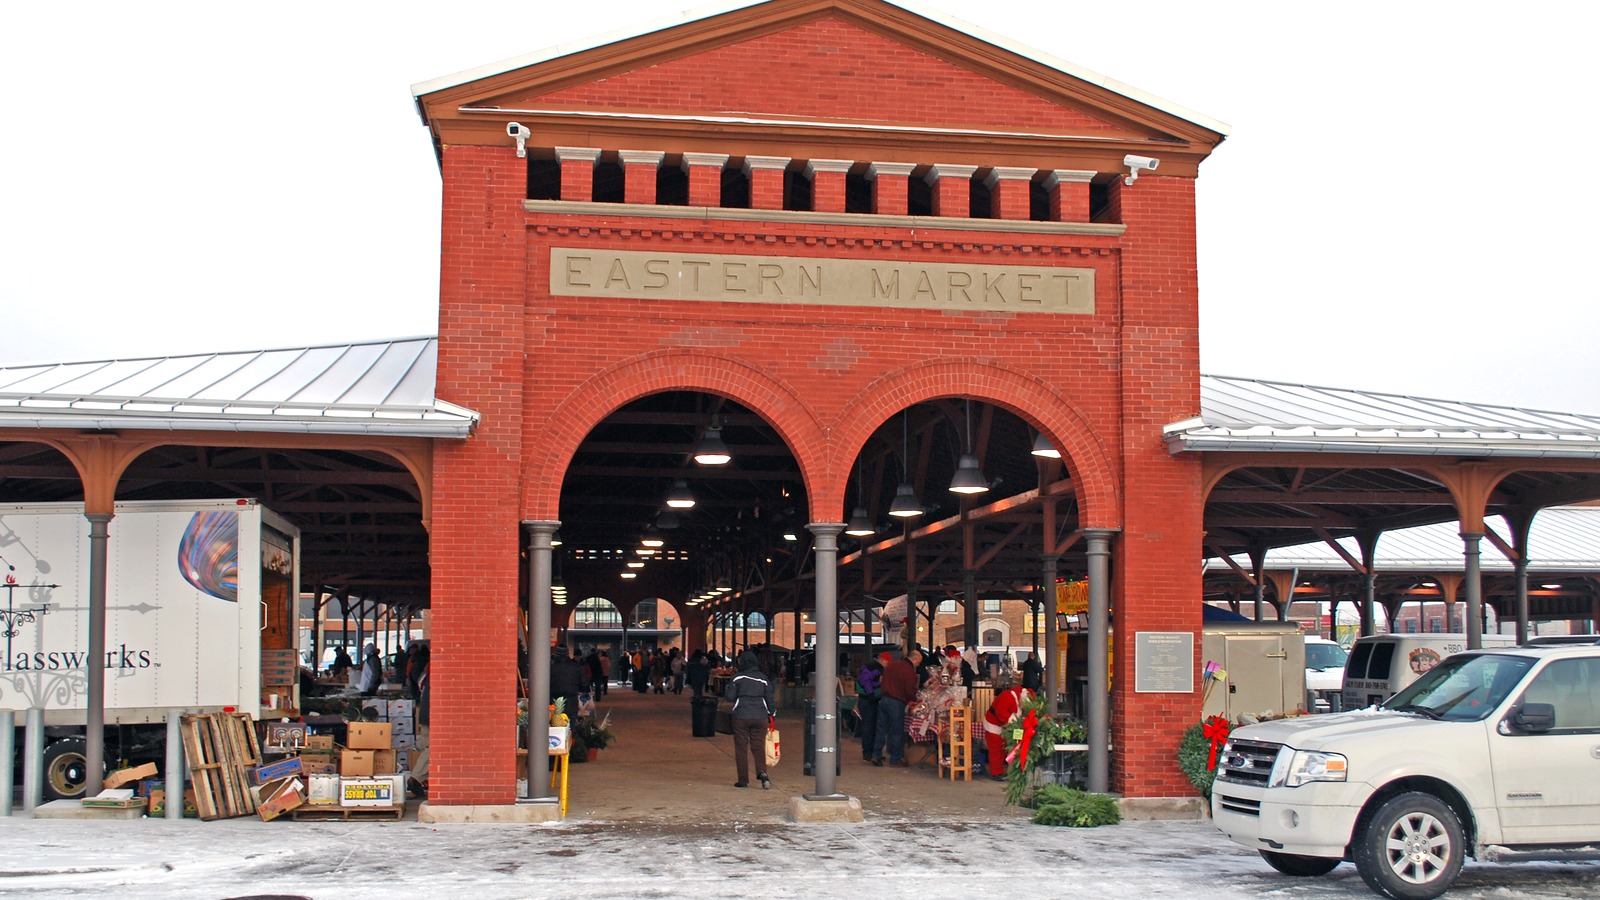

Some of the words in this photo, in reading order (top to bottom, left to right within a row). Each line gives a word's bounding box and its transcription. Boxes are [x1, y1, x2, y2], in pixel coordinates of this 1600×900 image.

[566, 256, 822, 296] EASTERN
[871, 268, 1080, 306] MARKET
[0, 643, 151, 671] lasswrks
[345, 789, 365, 798] BRASS
[365, 789, 377, 798] TOP
